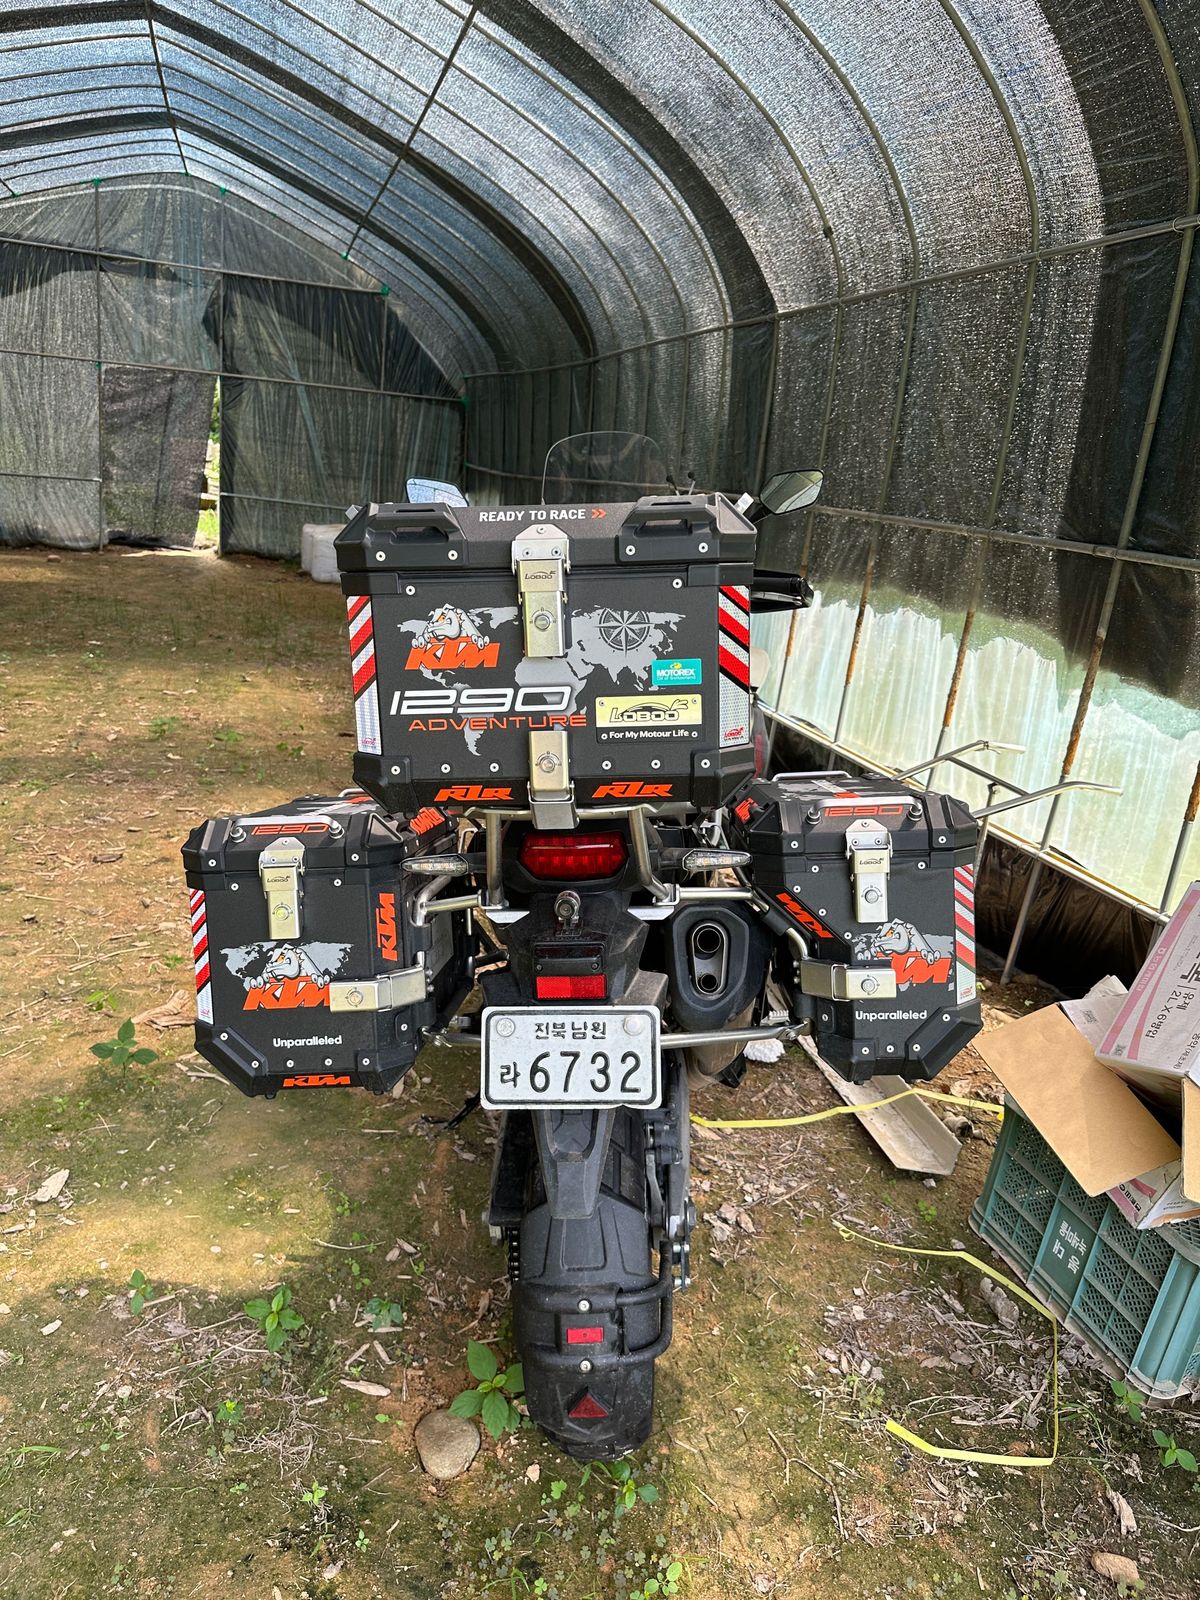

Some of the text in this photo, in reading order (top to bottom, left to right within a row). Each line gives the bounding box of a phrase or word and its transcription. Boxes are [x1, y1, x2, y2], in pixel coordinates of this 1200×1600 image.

[479, 508, 586, 522] READY TO RACE
[405, 636, 500, 670] KTM
[656, 668, 697, 677] MOTOREX
[390, 685, 572, 716] 1290
[408, 715, 588, 732] ADVENTURE
[609, 729, 689, 740] For My Motour Life
[825, 806, 904, 817] 1290
[251, 823, 329, 836] 1290
[775, 891, 834, 939] KTM
[375, 892, 398, 962] KTM
[242, 975, 330, 1012] KTM
[855, 1009, 928, 1023] Unparalleled
[571, 1021, 607, 1040] 남원
[272, 1034, 343, 1049] Unparalleled
[499, 1050, 642, 1094] 라 6732
[283, 1074, 351, 1088] KTM
